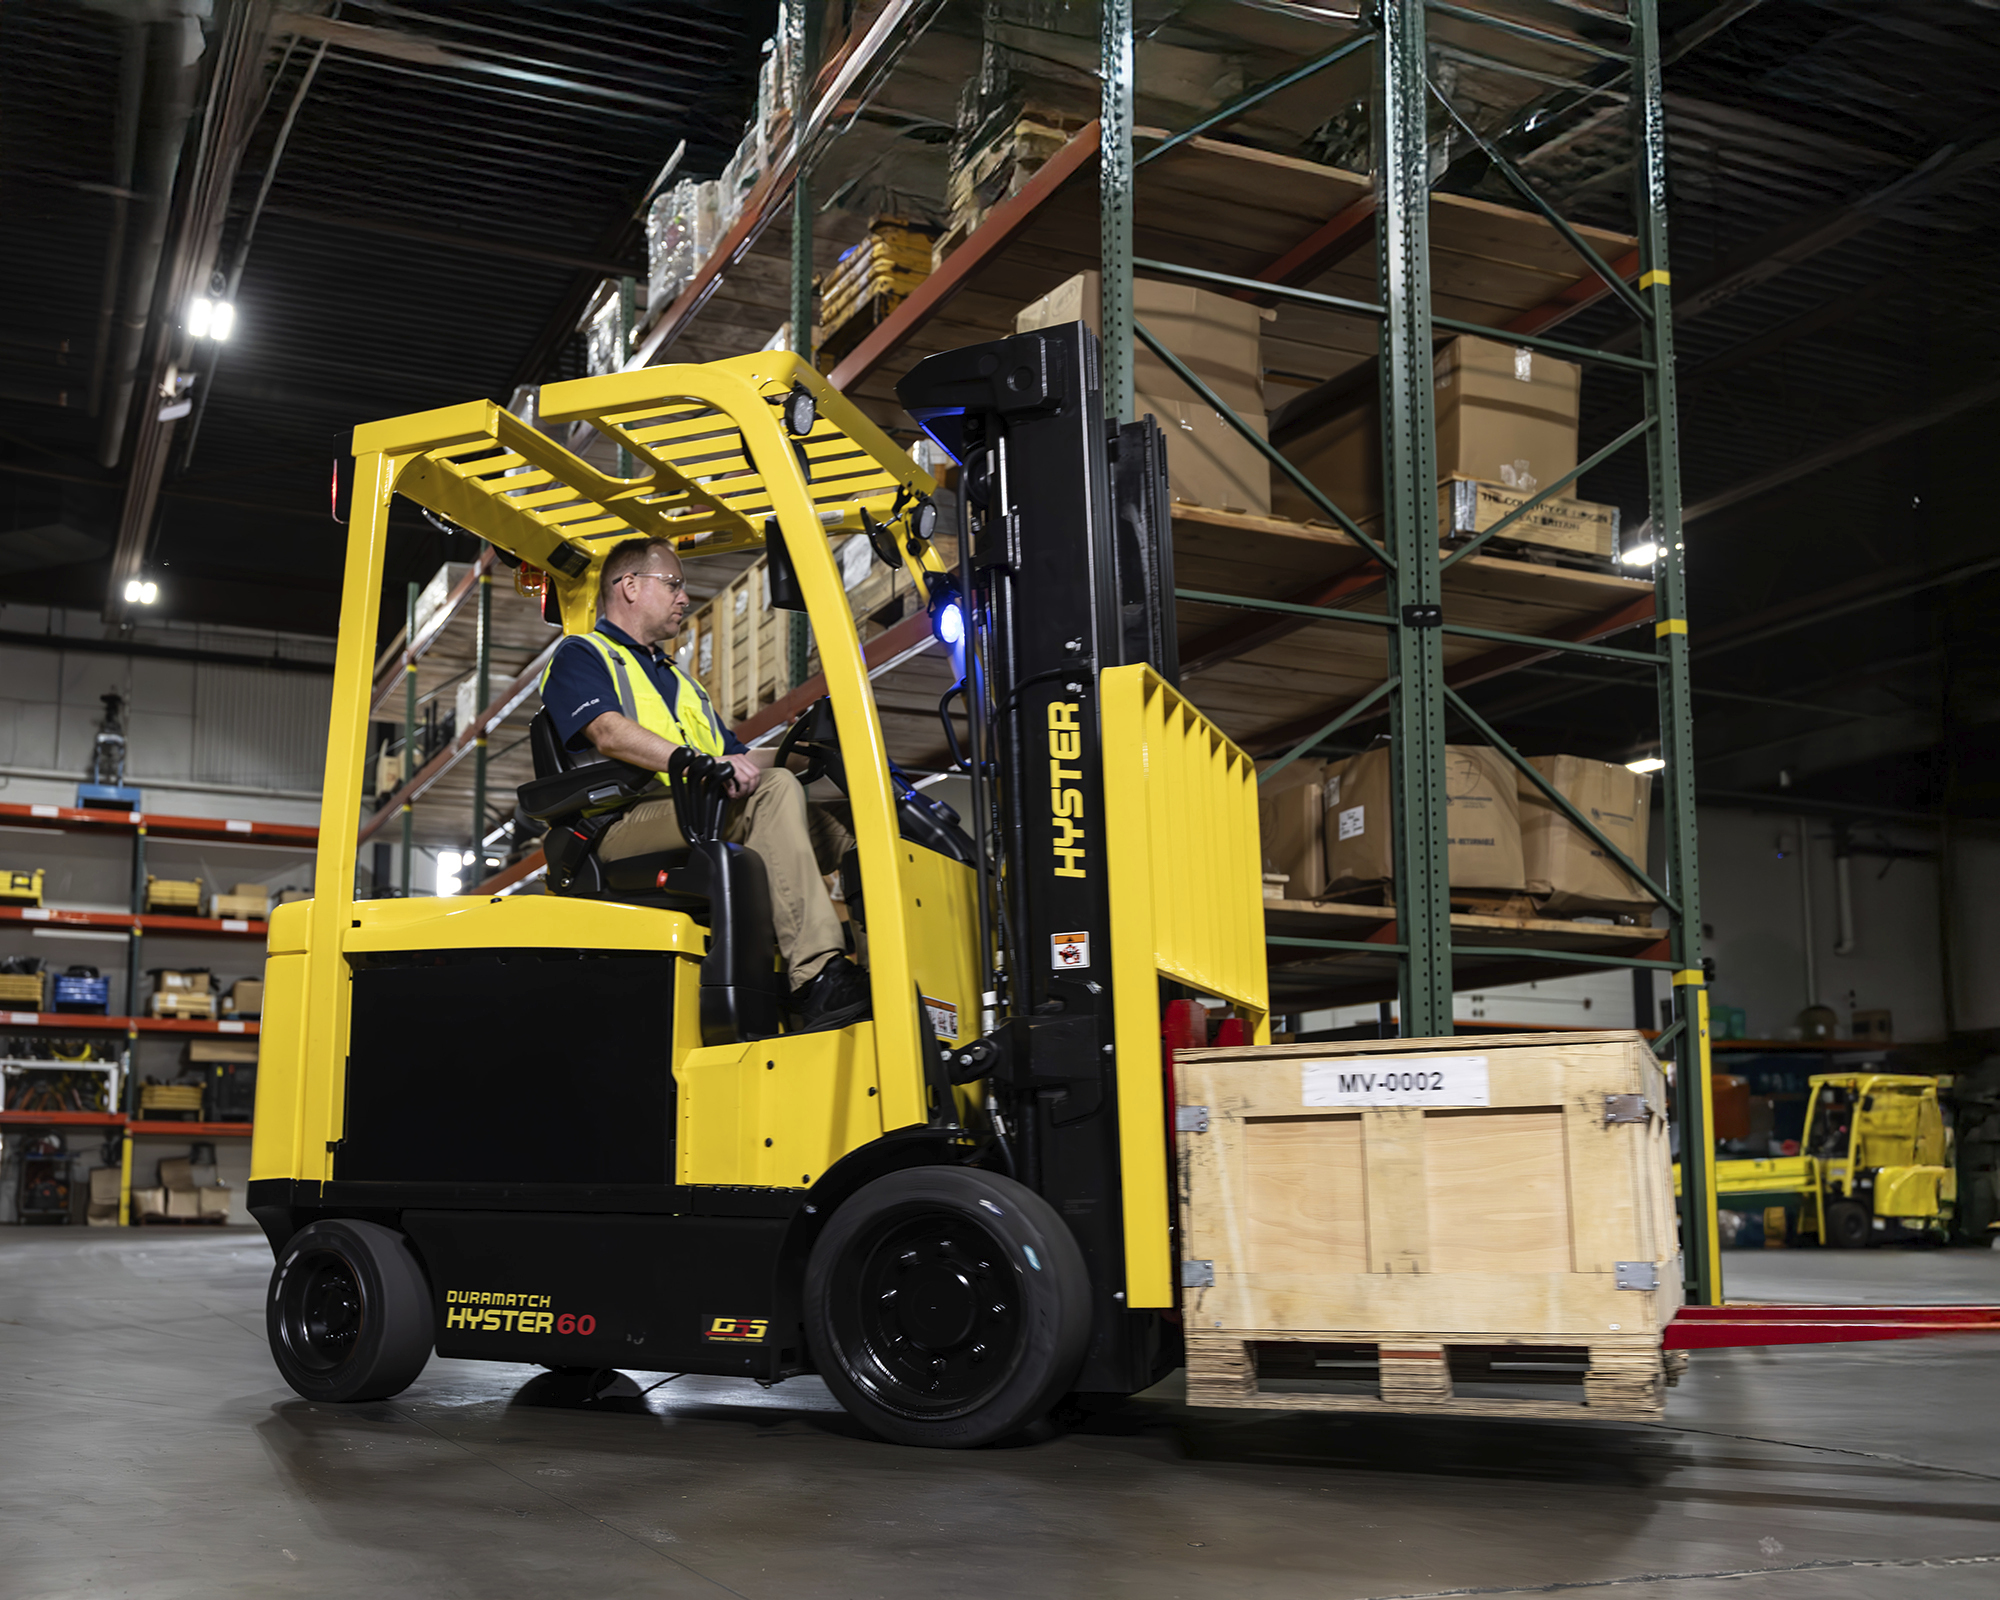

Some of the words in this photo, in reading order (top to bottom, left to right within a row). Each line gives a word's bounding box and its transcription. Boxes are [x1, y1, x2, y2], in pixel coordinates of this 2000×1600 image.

[1048, 701, 1086, 879] HYSTER
[1338, 1071, 1444, 1092] MV-0002
[446, 1290, 551, 1308] DURAMATCH
